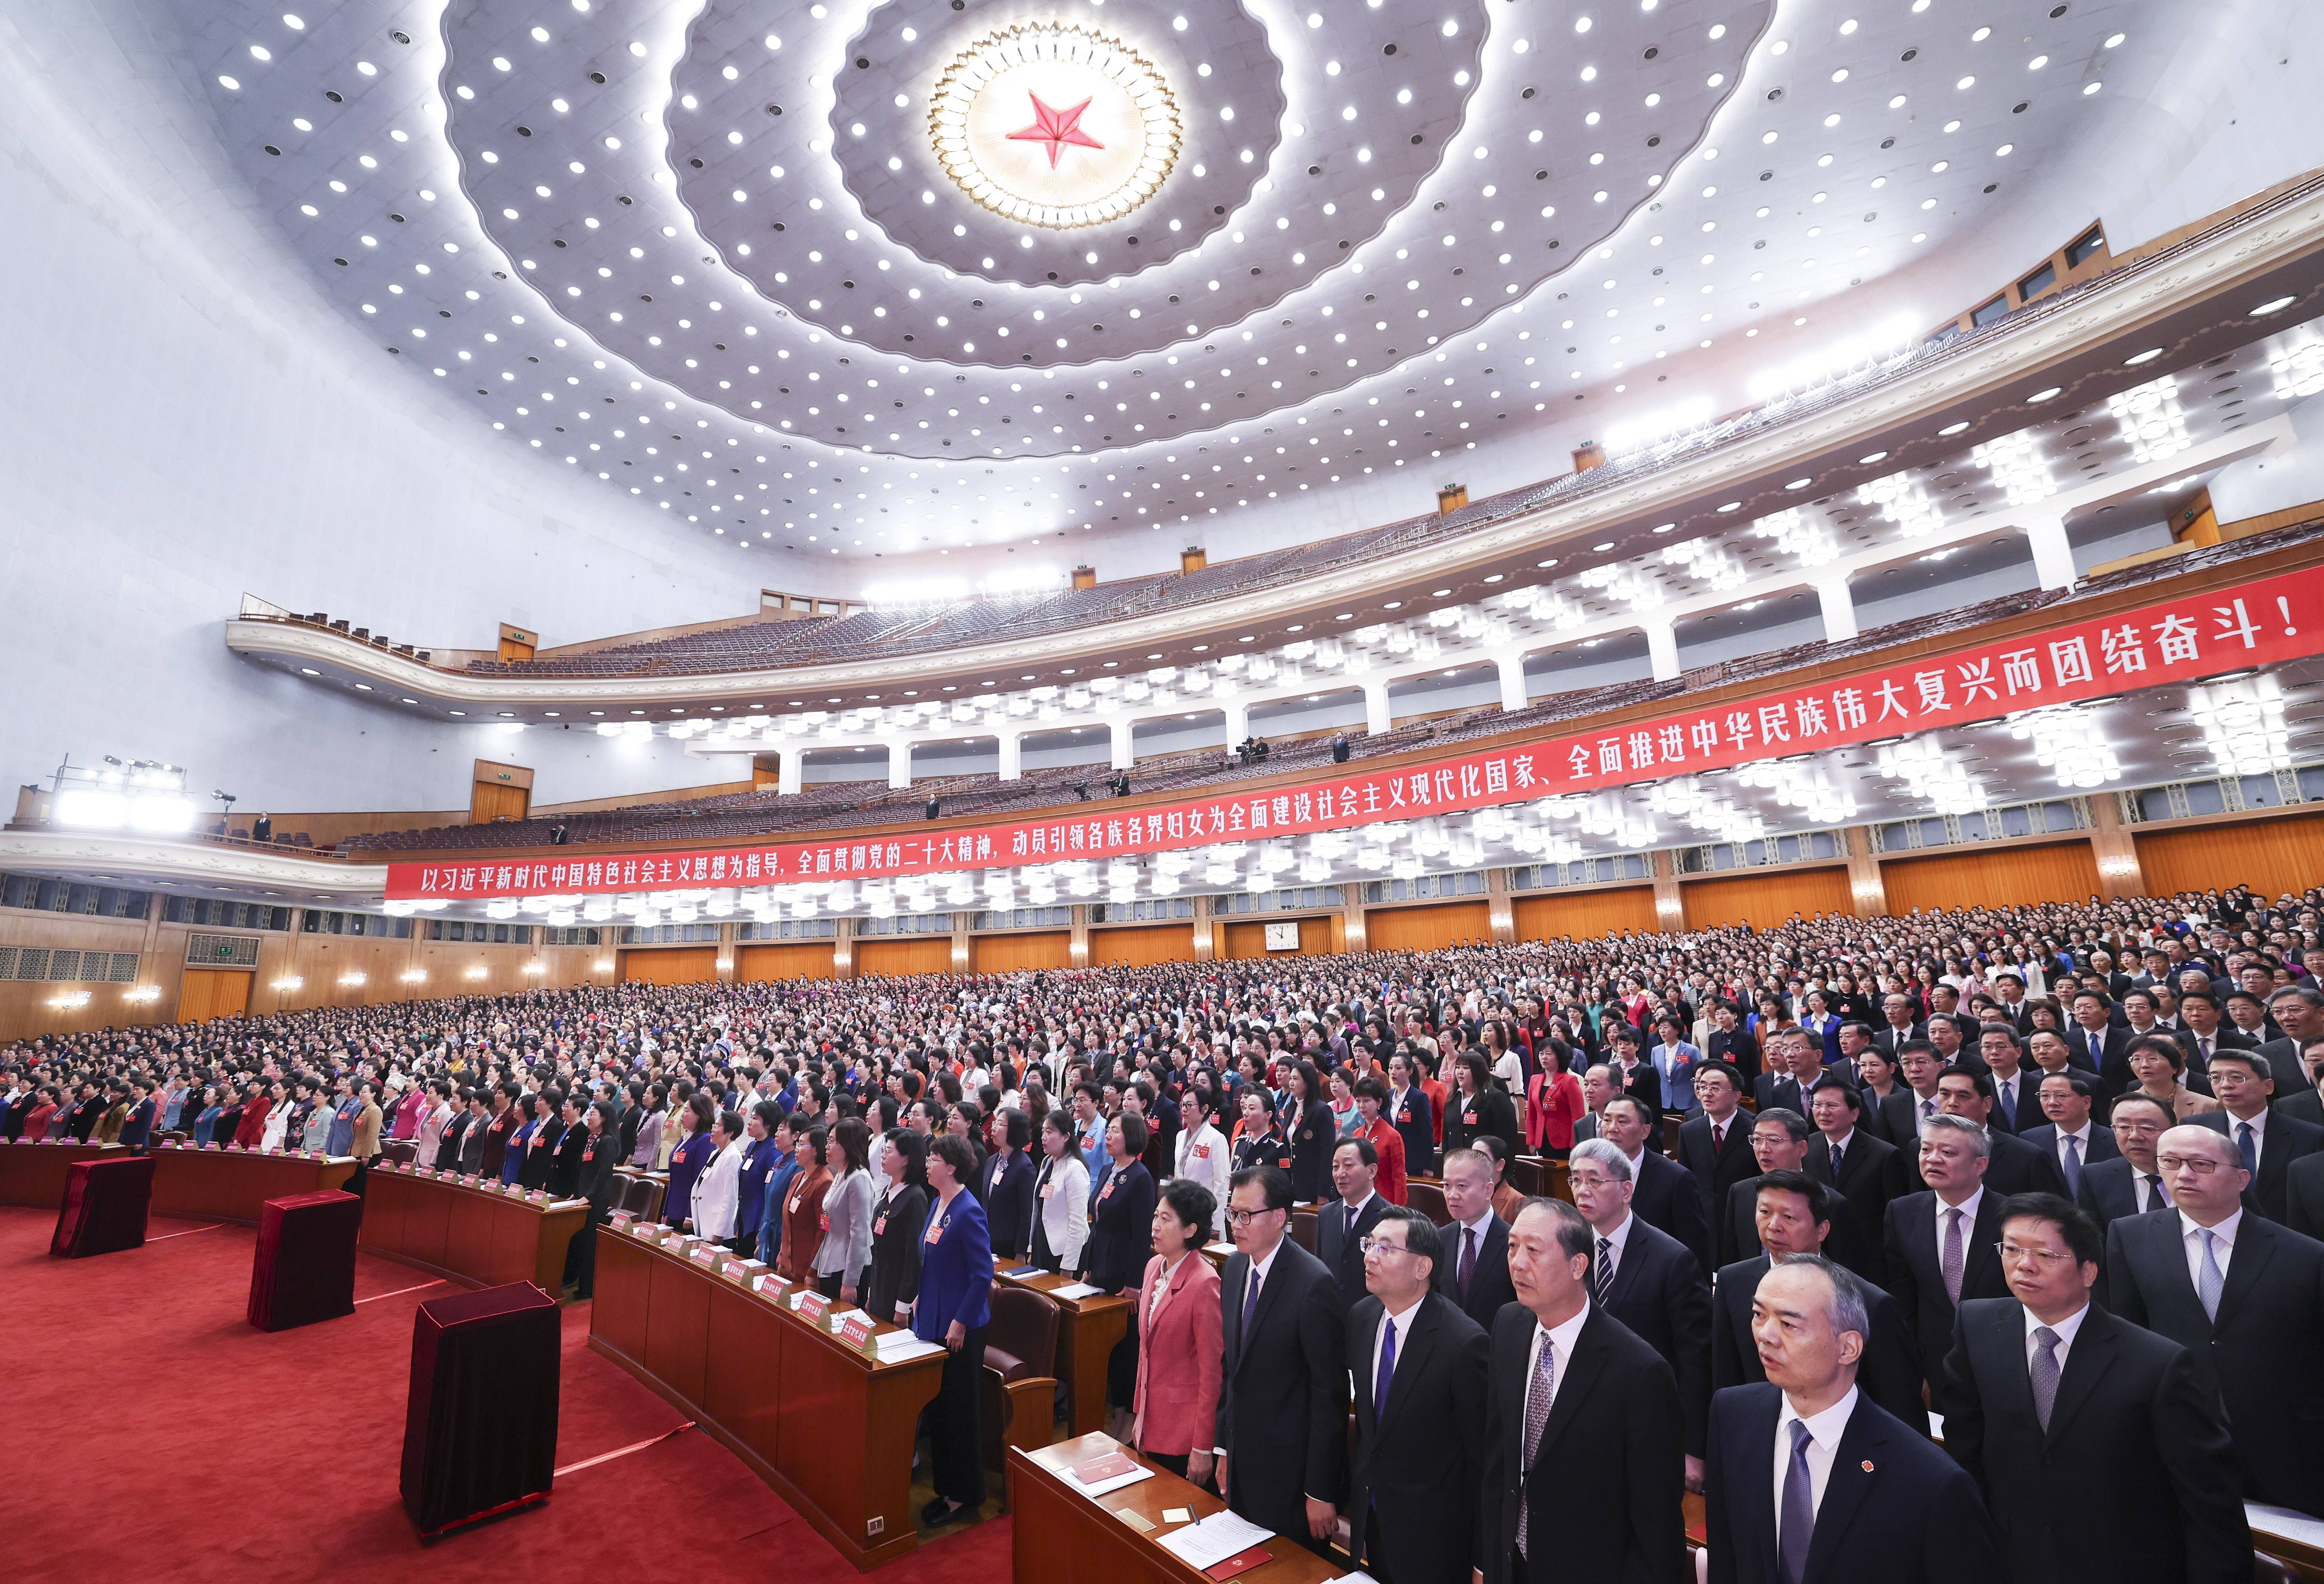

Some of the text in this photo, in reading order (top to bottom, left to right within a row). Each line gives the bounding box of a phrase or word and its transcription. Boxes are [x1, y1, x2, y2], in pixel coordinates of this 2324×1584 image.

[763, 1281, 781, 1295] 河北省代表团
[801, 1300, 822, 1317] 天津市代表团
[843, 1324, 867, 1342] 北京市代表团
